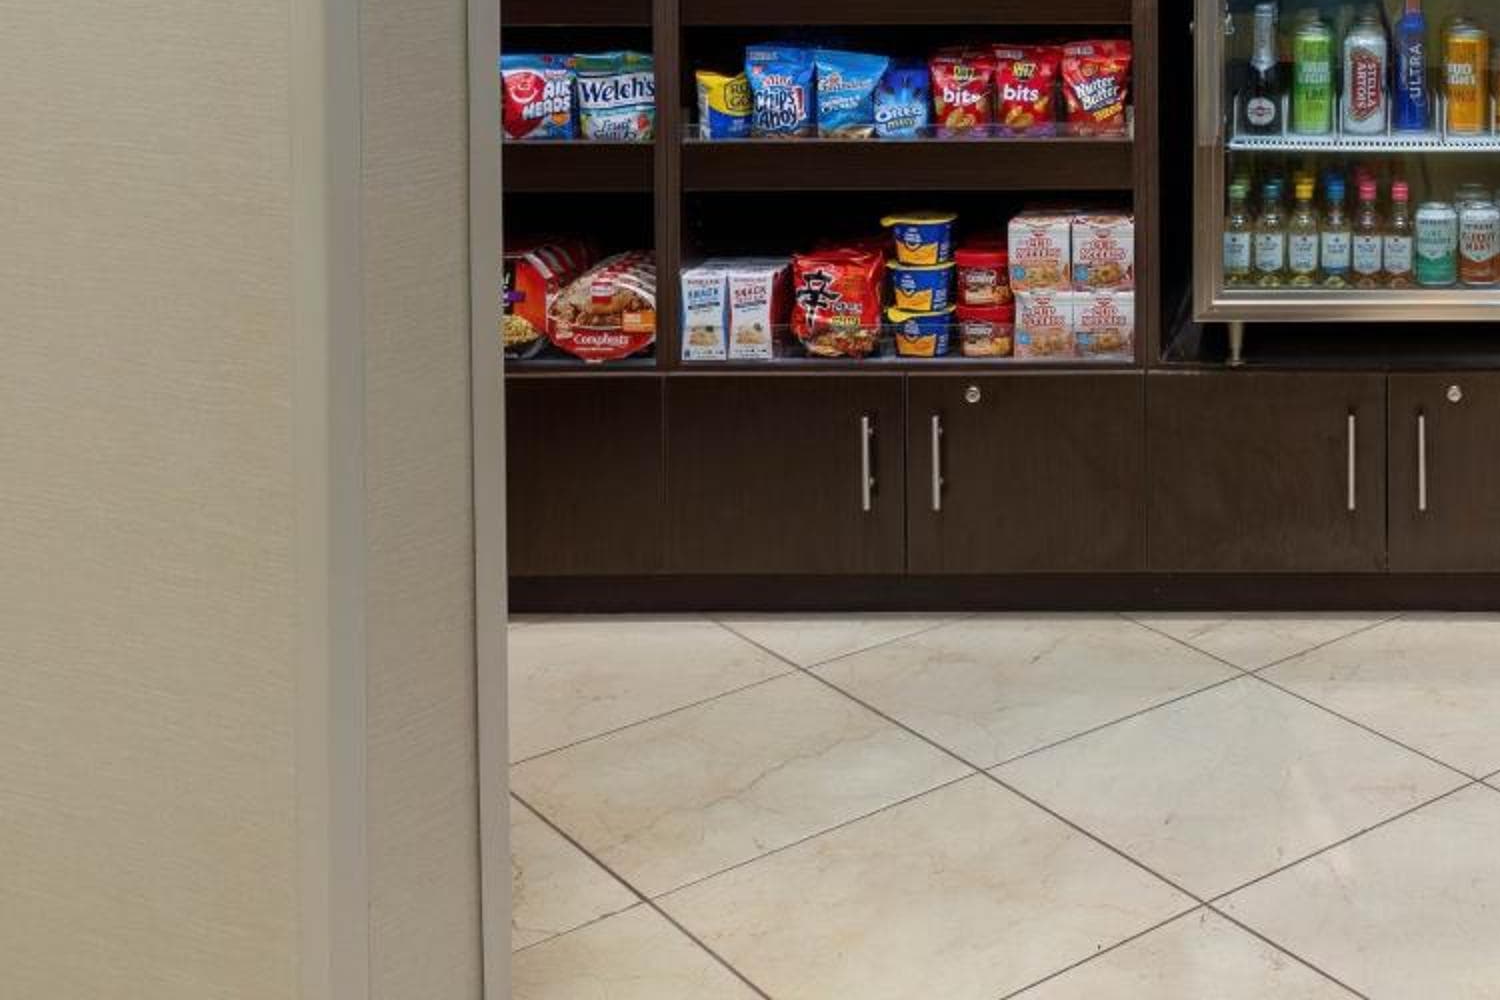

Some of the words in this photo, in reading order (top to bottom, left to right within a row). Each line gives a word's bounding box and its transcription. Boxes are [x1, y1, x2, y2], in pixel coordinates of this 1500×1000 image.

[580, 76, 655, 103] Welch's
[1003, 85, 1039, 102] bits
[1356, 62, 1365, 109] ARTOIS
[1367, 62, 1377, 107] STELLA
[1410, 43, 1423, 99] ULTRA
